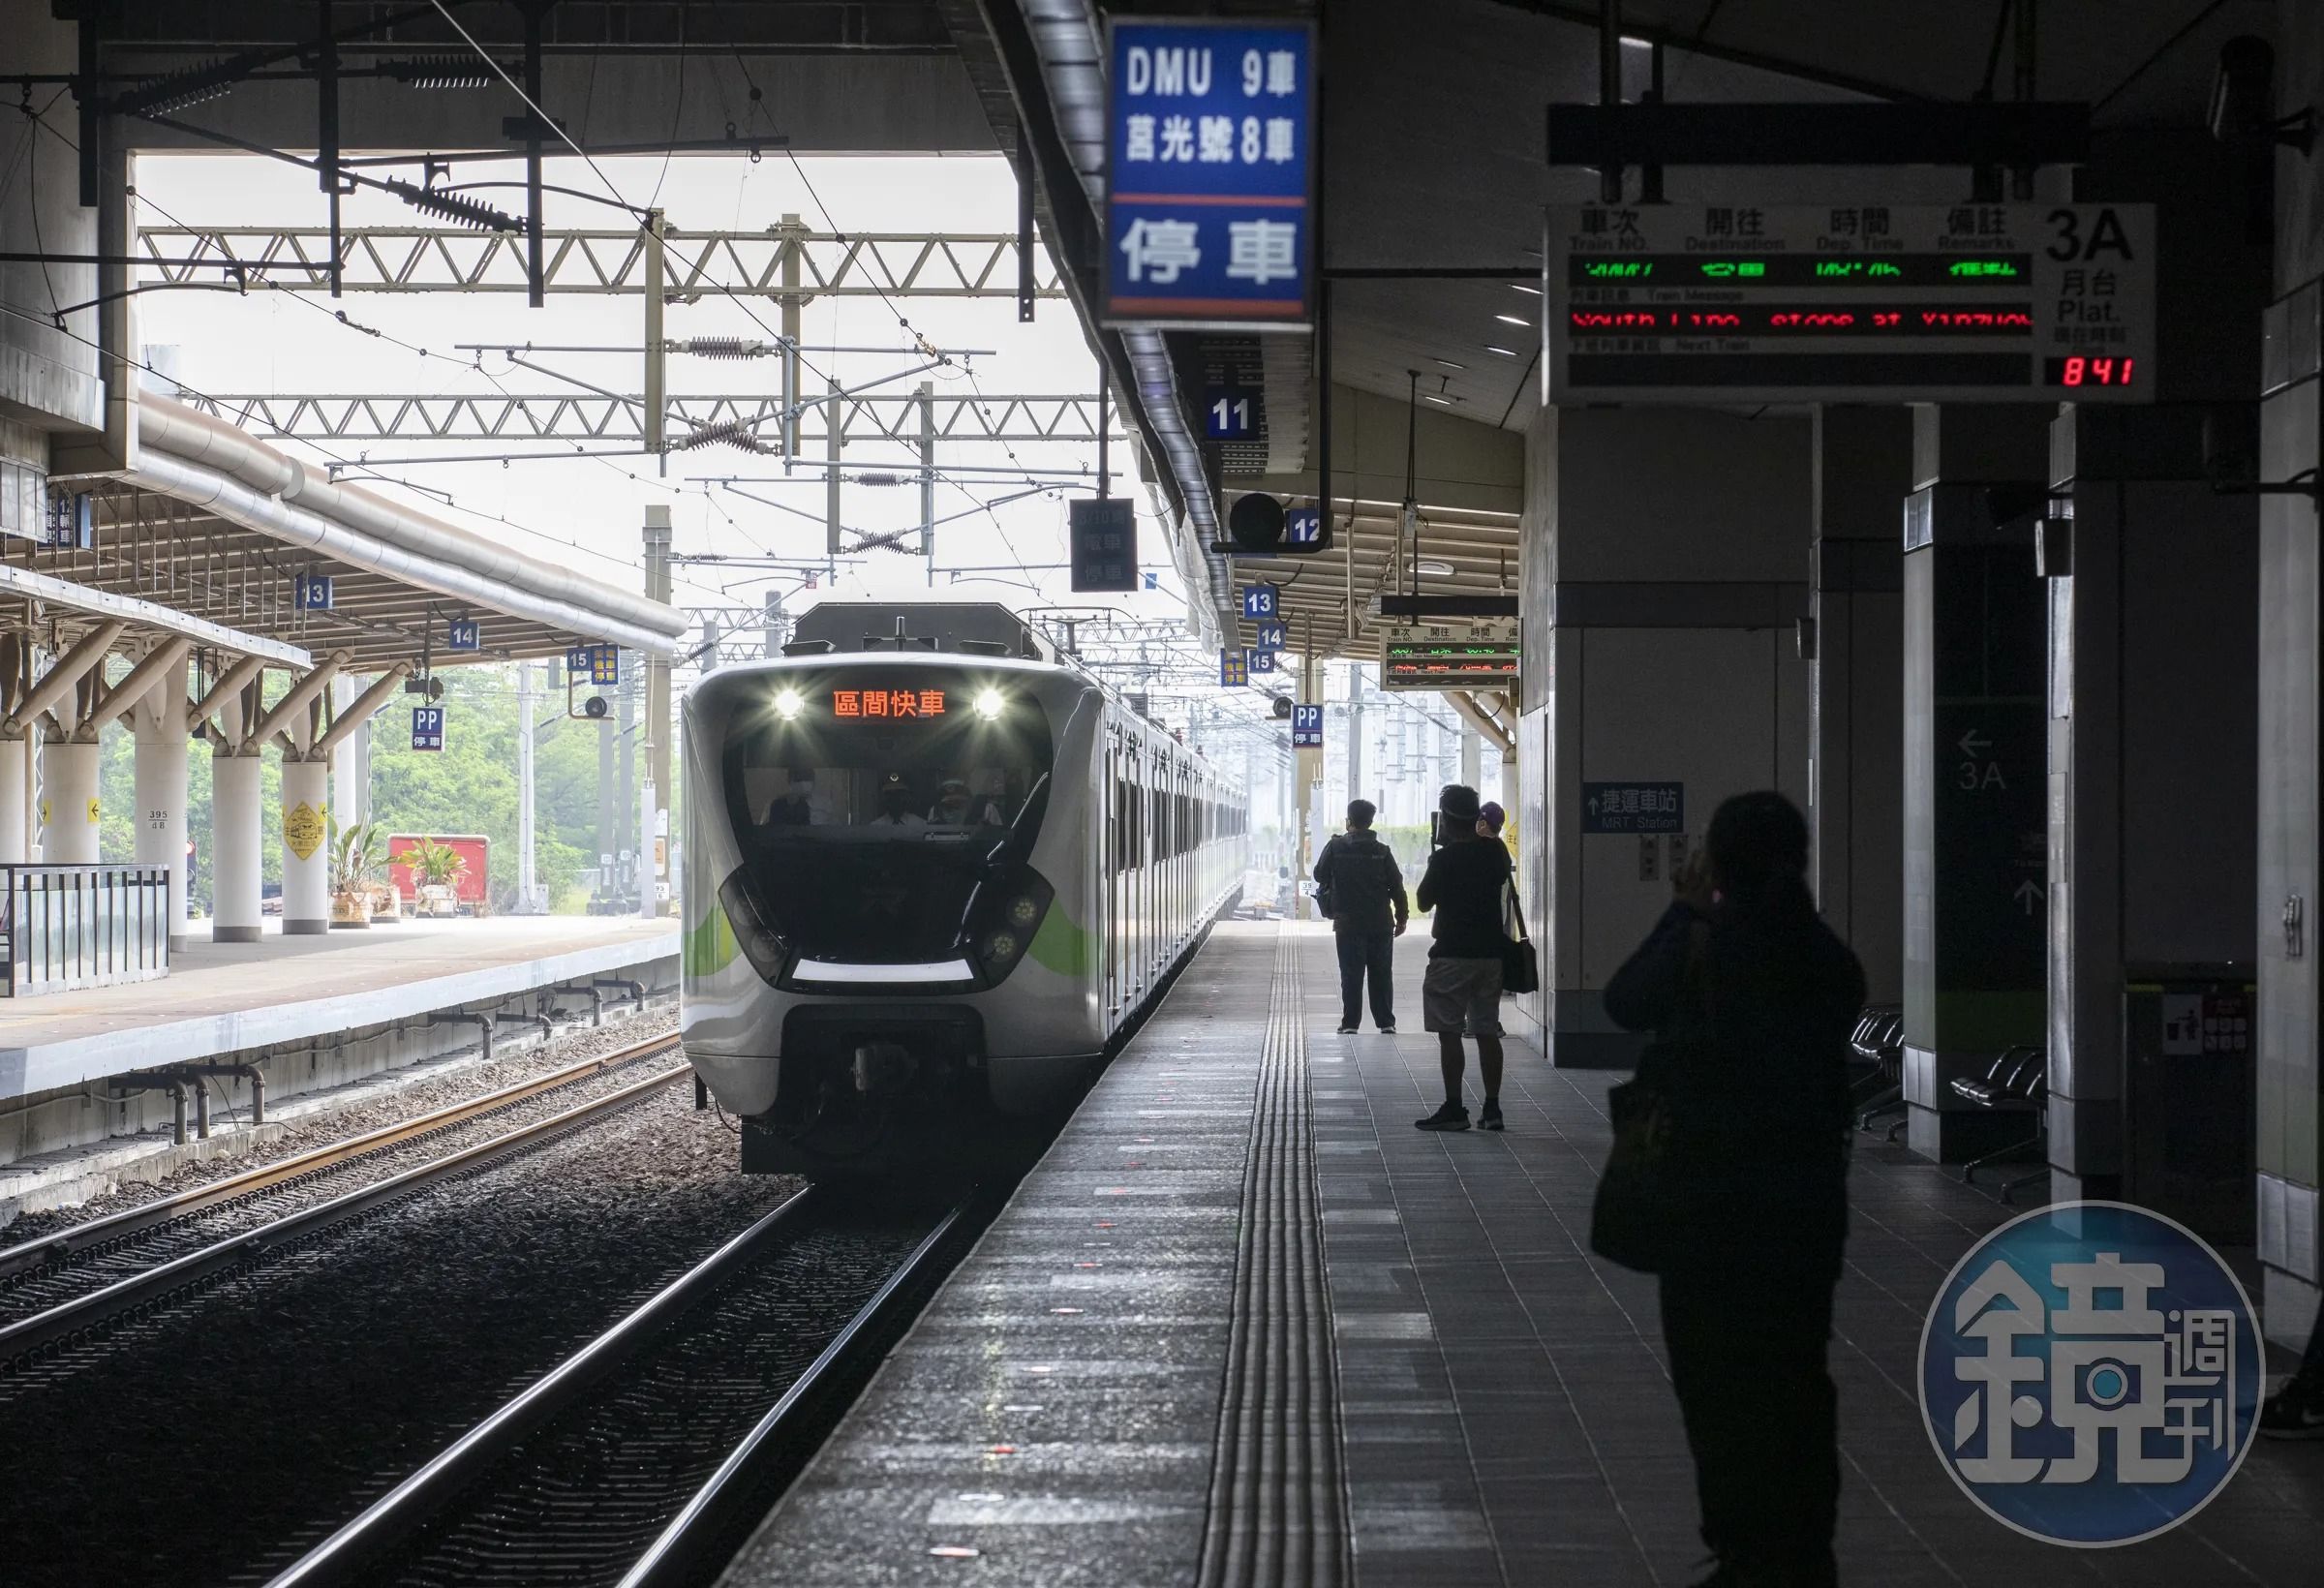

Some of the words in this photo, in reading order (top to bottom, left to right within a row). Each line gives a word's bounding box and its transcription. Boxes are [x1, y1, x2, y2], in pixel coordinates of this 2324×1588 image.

[1127, 46, 1211, 96] DMU
[1241, 48, 1296, 98] 9車
[1581, 208, 1639, 235] 車次
[1706, 208, 1764, 235] 開往
[1830, 207, 1889, 235] 時間
[1947, 207, 2006, 235] 備註
[2047, 209, 2133, 261] 3A
[1119, 218, 1298, 285] 停車
[2063, 269, 2116, 296] 月台
[2059, 299, 2121, 322] Plat.
[1212, 398, 1248, 430] 11
[1294, 518, 1320, 542] 12
[1248, 594, 1271, 612] 13
[453, 627, 474, 644] 14
[1262, 629, 1282, 645] 14
[1471, 627, 1490, 637] 時間
[569, 653, 587, 667] 15
[1252, 656, 1269, 669] 15
[834, 689, 945, 717] 區間快車
[417, 710, 438, 730] PP
[1298, 707, 1318, 727] PP
[413, 737, 441, 747] 停車
[1294, 733, 1321, 744] 停車
[1959, 761, 2007, 790] 3A
[1602, 788, 1678, 814] 捷運車站
[149, 809, 168, 819] 395
[1602, 816, 1631, 831] MRT
[1636, 816, 1678, 831] Station
